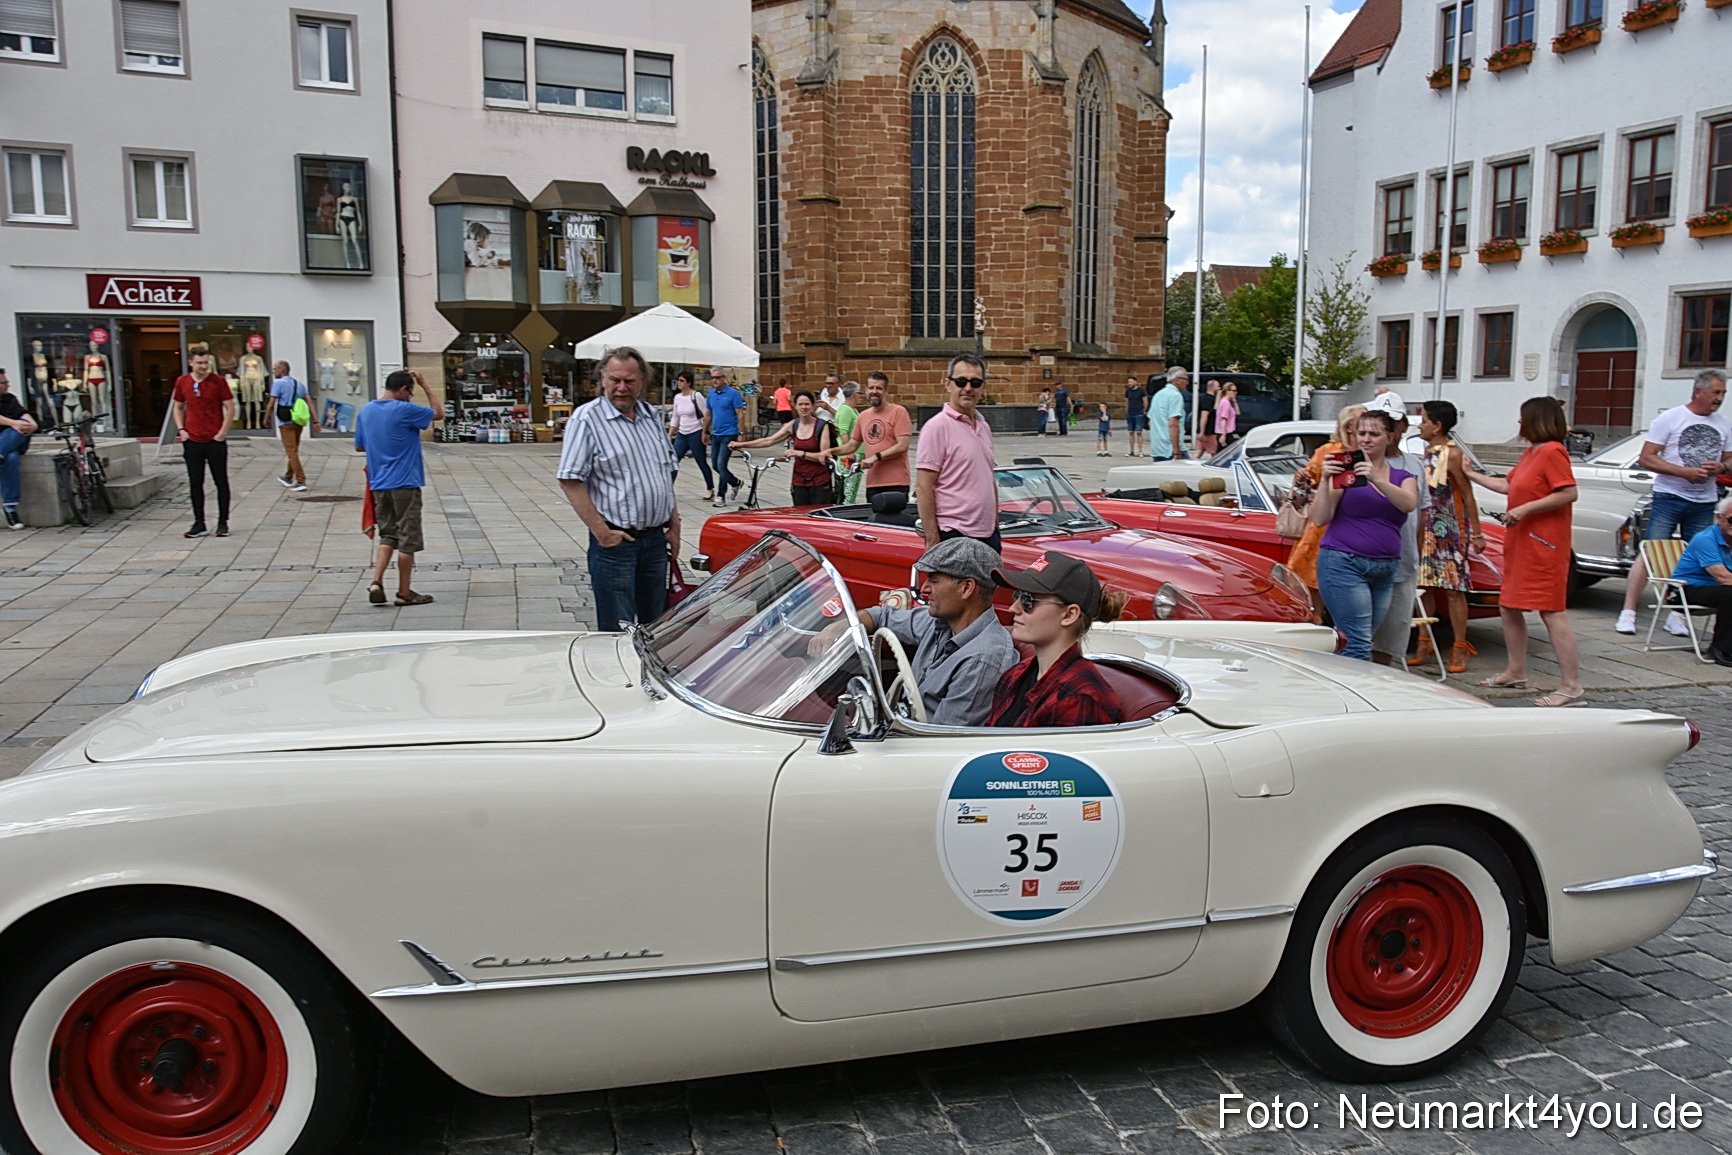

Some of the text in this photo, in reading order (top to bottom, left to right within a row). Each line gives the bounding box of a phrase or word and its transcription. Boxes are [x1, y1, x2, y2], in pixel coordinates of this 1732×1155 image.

[626, 146, 717, 177] RACKL
[638, 173, 707, 189] am Rathaus
[567, 223, 597, 239] RACKL
[98, 277, 192, 306] Achatz
[1383, 399, 1392, 407] A
[986, 780, 1059, 790] SONNLEITNER
[1017, 812, 1048, 820] HISCOX
[1003, 833, 1059, 873] 35
[472, 948, 664, 968] Chevrolet
